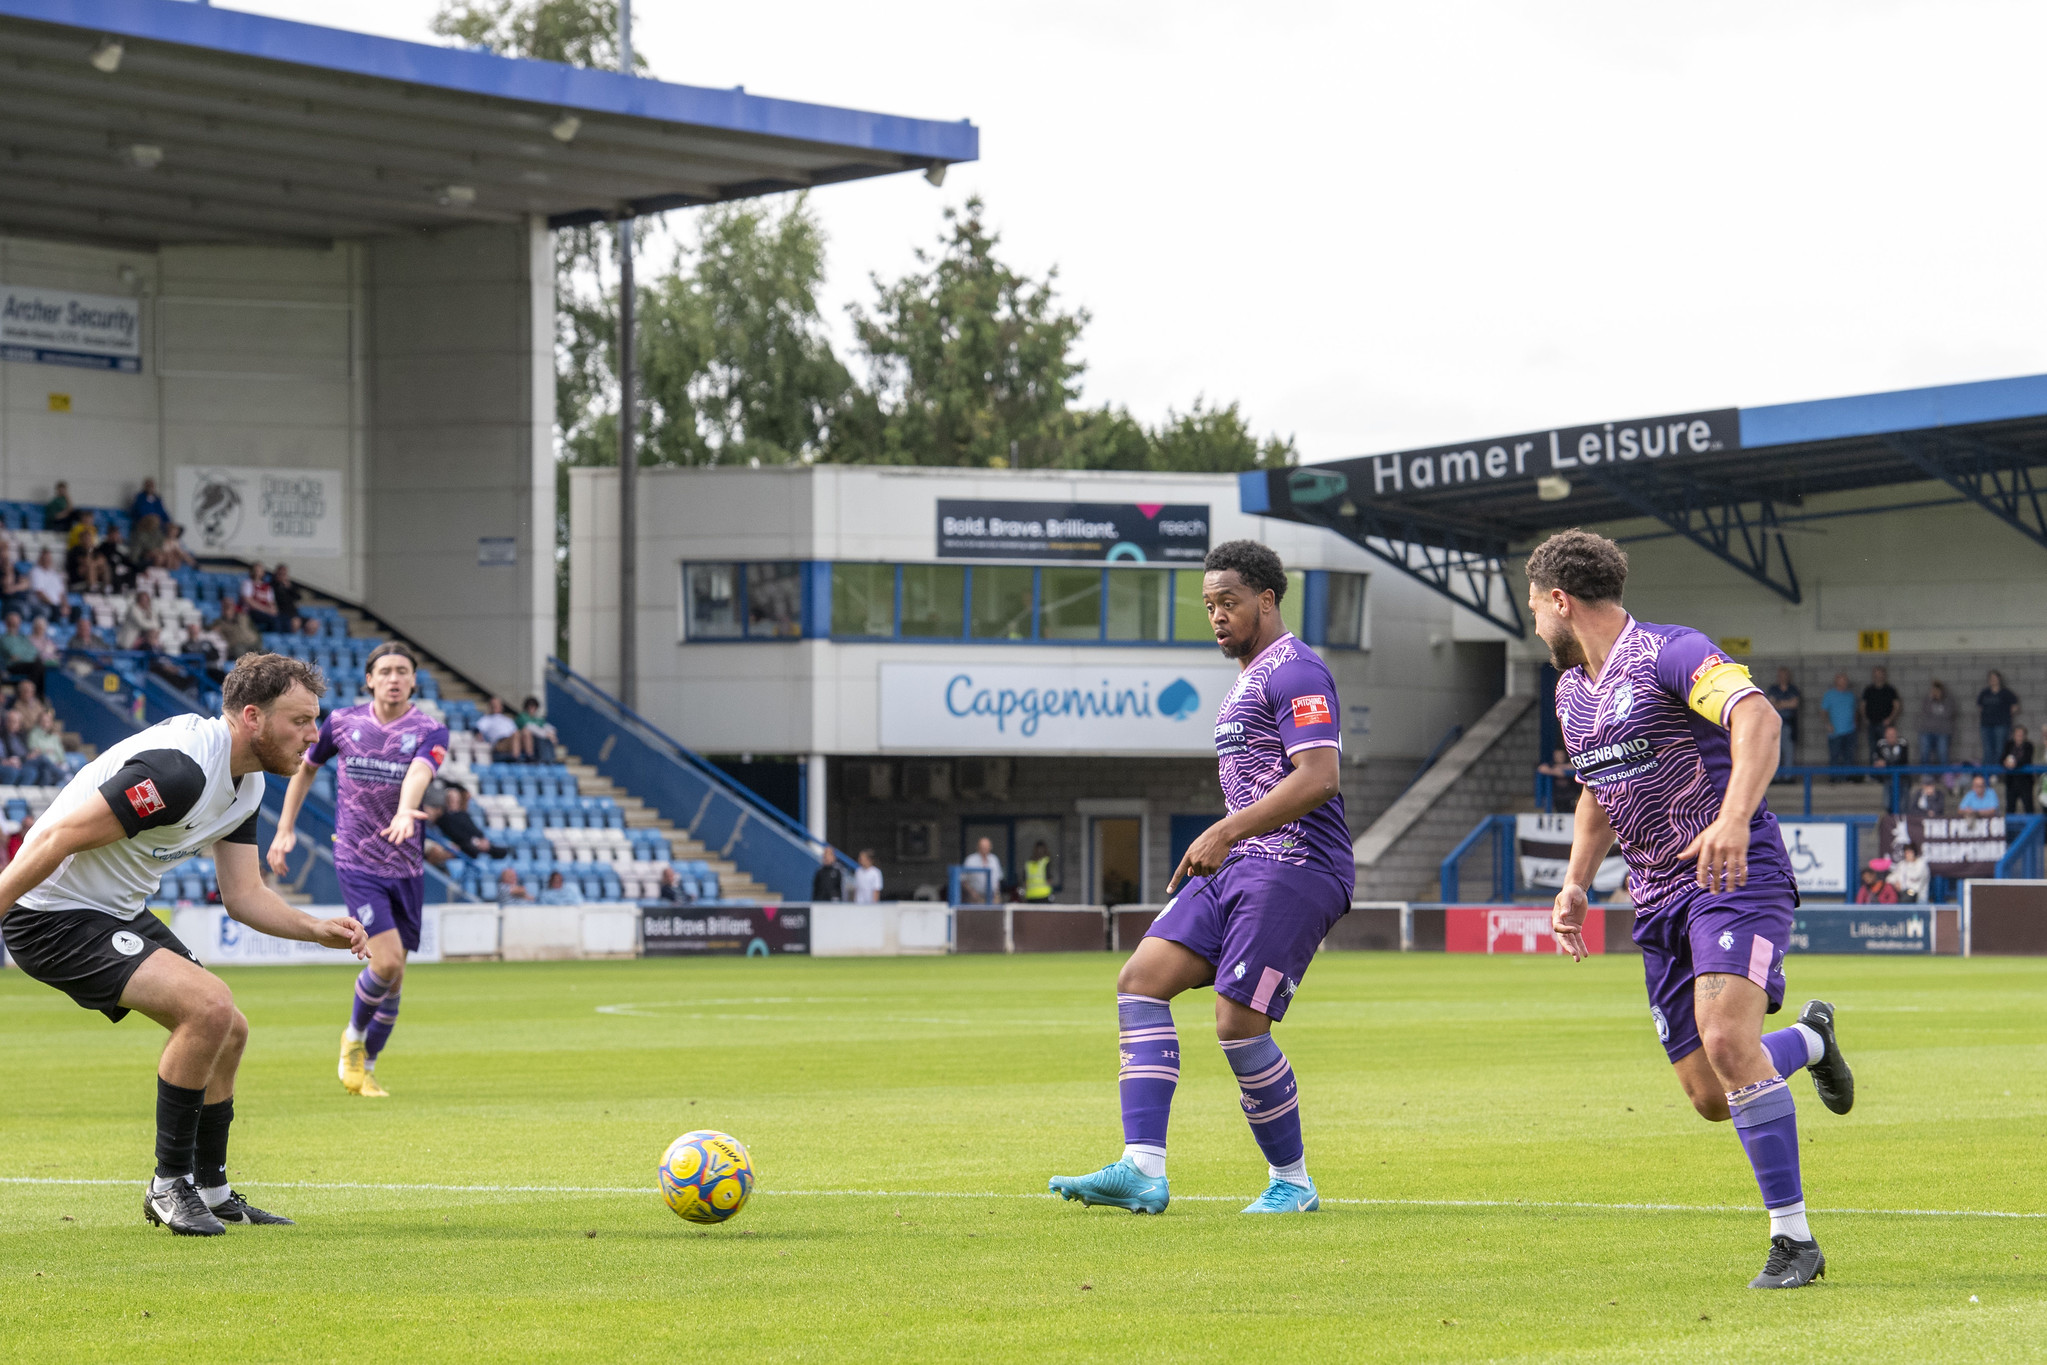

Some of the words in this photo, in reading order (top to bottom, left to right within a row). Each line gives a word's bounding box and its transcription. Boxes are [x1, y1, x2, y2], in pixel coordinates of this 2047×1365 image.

[3, 294, 62, 323] Archer
[66, 300, 135, 337] Security
[1373, 442, 1533, 495] Hamer
[1549, 419, 1712, 469] Leisure
[943, 516, 988, 536] Bold.
[989, 517, 1045, 538] Brave.
[1046, 518, 1119, 539] Brilliant.
[945, 674, 1153, 738] Capgemini
[1570, 738, 1650, 769] CREENBOND
[1617, 760, 1659, 780] SOLUTIONS
[1922, 817, 1948, 838] THE
[1850, 920, 1905, 939] Lilleshall
